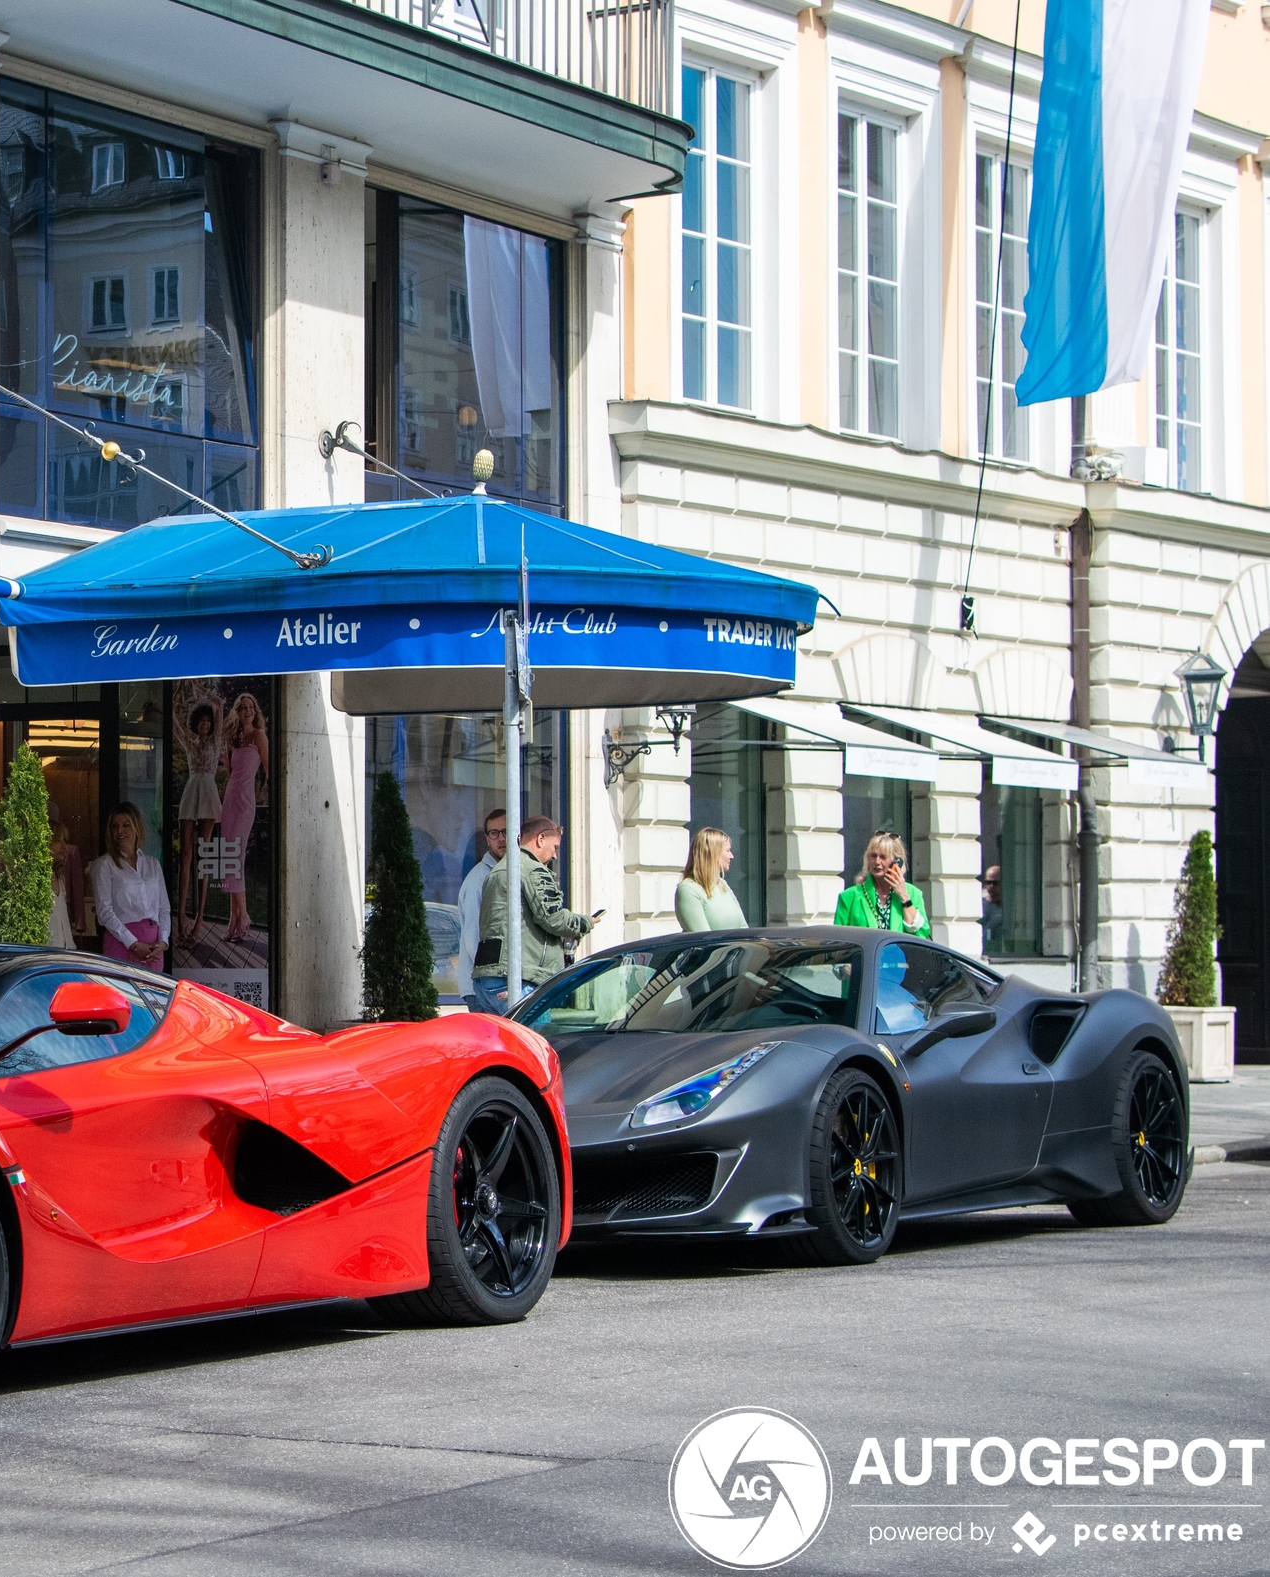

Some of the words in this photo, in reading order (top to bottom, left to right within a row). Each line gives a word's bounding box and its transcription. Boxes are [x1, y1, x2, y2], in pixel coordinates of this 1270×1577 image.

[52, 333, 175, 406] Pianista
[90, 623, 179, 658] Garden
[276, 612, 361, 647] Atelier
[471, 607, 561, 638] Nht
[562, 607, 617, 635] Club
[703, 617, 772, 648] TRADER
